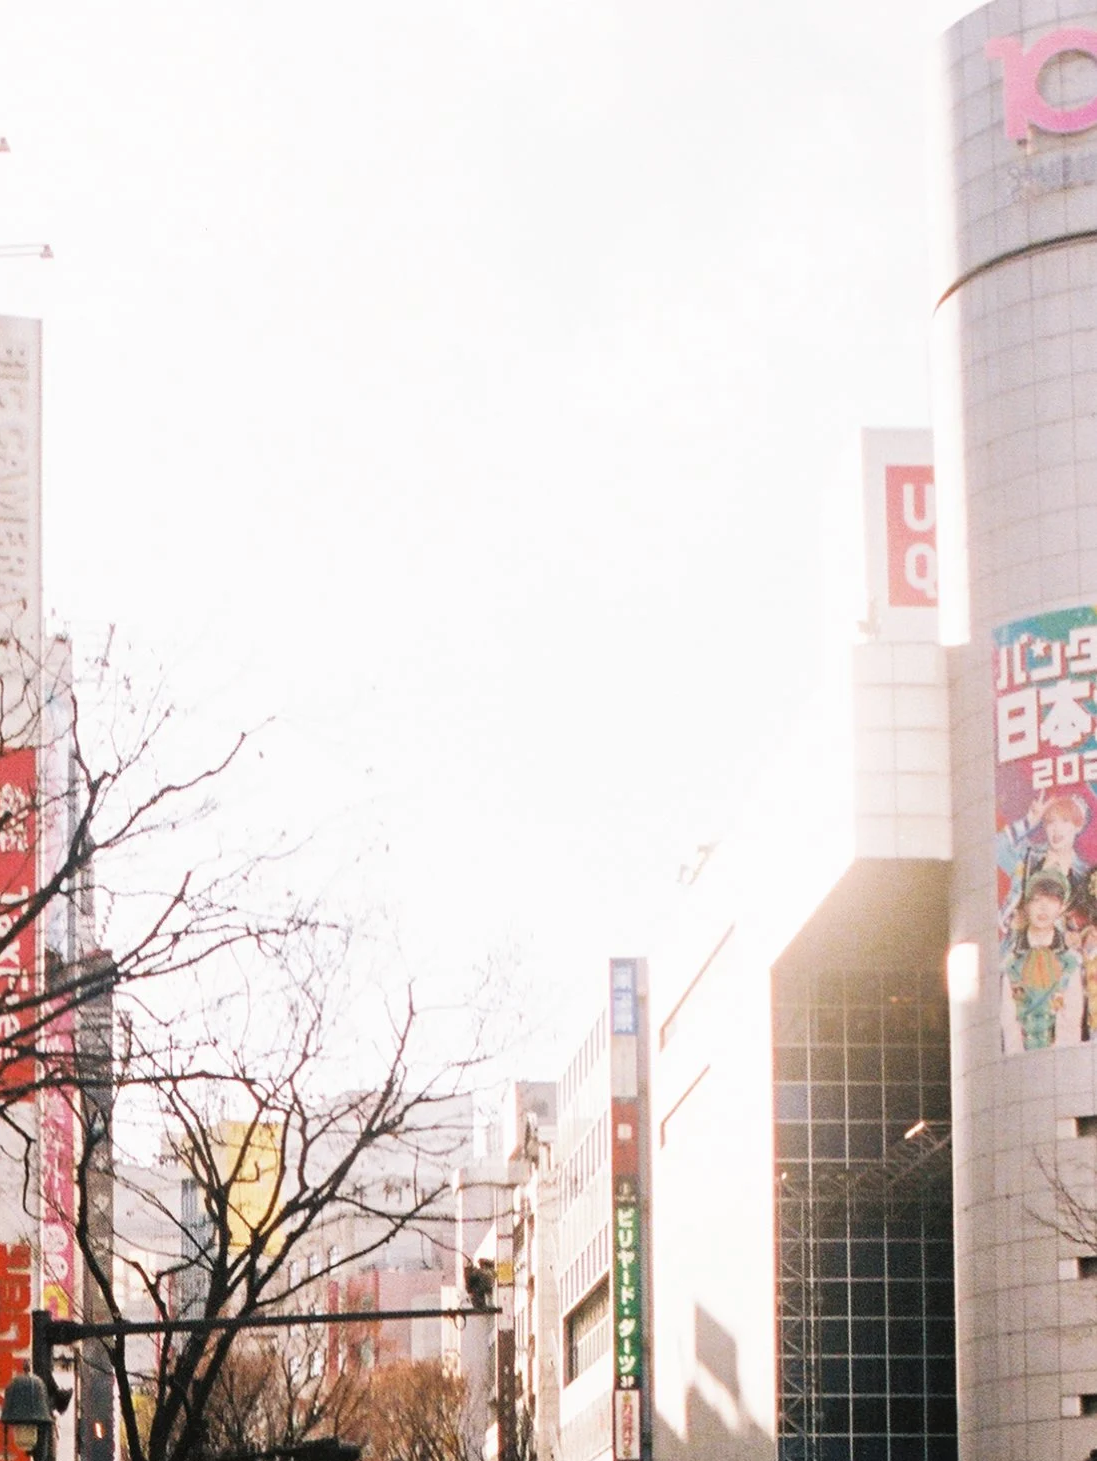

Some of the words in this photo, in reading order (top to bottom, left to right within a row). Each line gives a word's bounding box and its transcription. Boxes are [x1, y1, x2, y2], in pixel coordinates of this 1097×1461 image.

[999, 680, 1097, 763] 日本
[617, 1207, 636, 1374] ビリヤード・ダーツ
